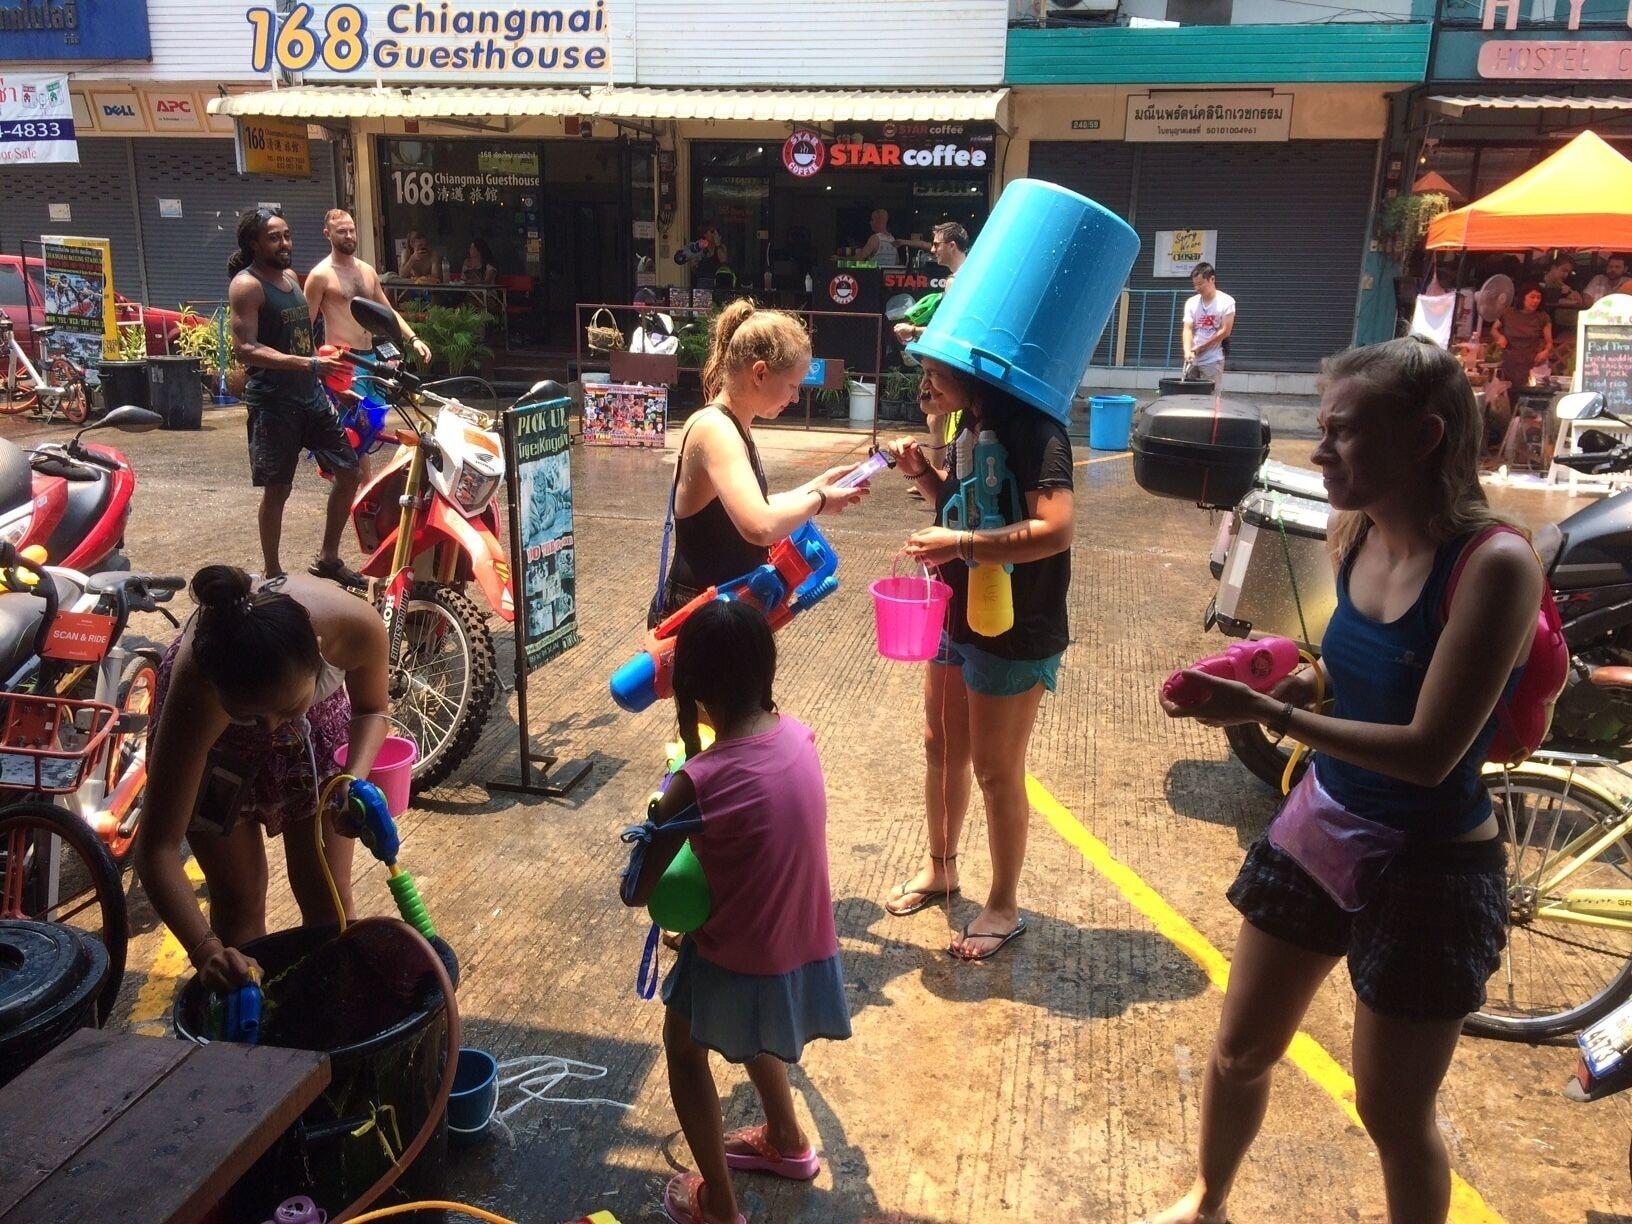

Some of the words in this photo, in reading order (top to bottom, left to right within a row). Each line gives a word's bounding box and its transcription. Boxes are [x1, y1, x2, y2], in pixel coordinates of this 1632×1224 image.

[246, 3, 369, 73] 168
[387, 1, 607, 42] Chiangmai
[373, 39, 607, 70] Guesthouse
[1494, 47, 1590, 72] HOSTEL
[103, 105, 135, 117] DELL
[157, 100, 191, 113] APC
[246, 127, 265, 150] 168
[790, 132, 819, 146] STAR
[15, 147, 36, 160] Sale
[830, 143, 902, 166] STAR
[903, 144, 987, 167] coffee
[788, 162, 820, 176] COFFEE
[391, 171, 435, 207] 168
[434, 173, 484, 188] Chiangmai
[485, 173, 541, 187] Guesthouse
[885, 275, 928, 288] STAR
[518, 411, 546, 436] PICK
[53, 630, 79, 641] SCAN
[80, 633, 87, 641] &
[88, 634, 107, 644] RIDE
